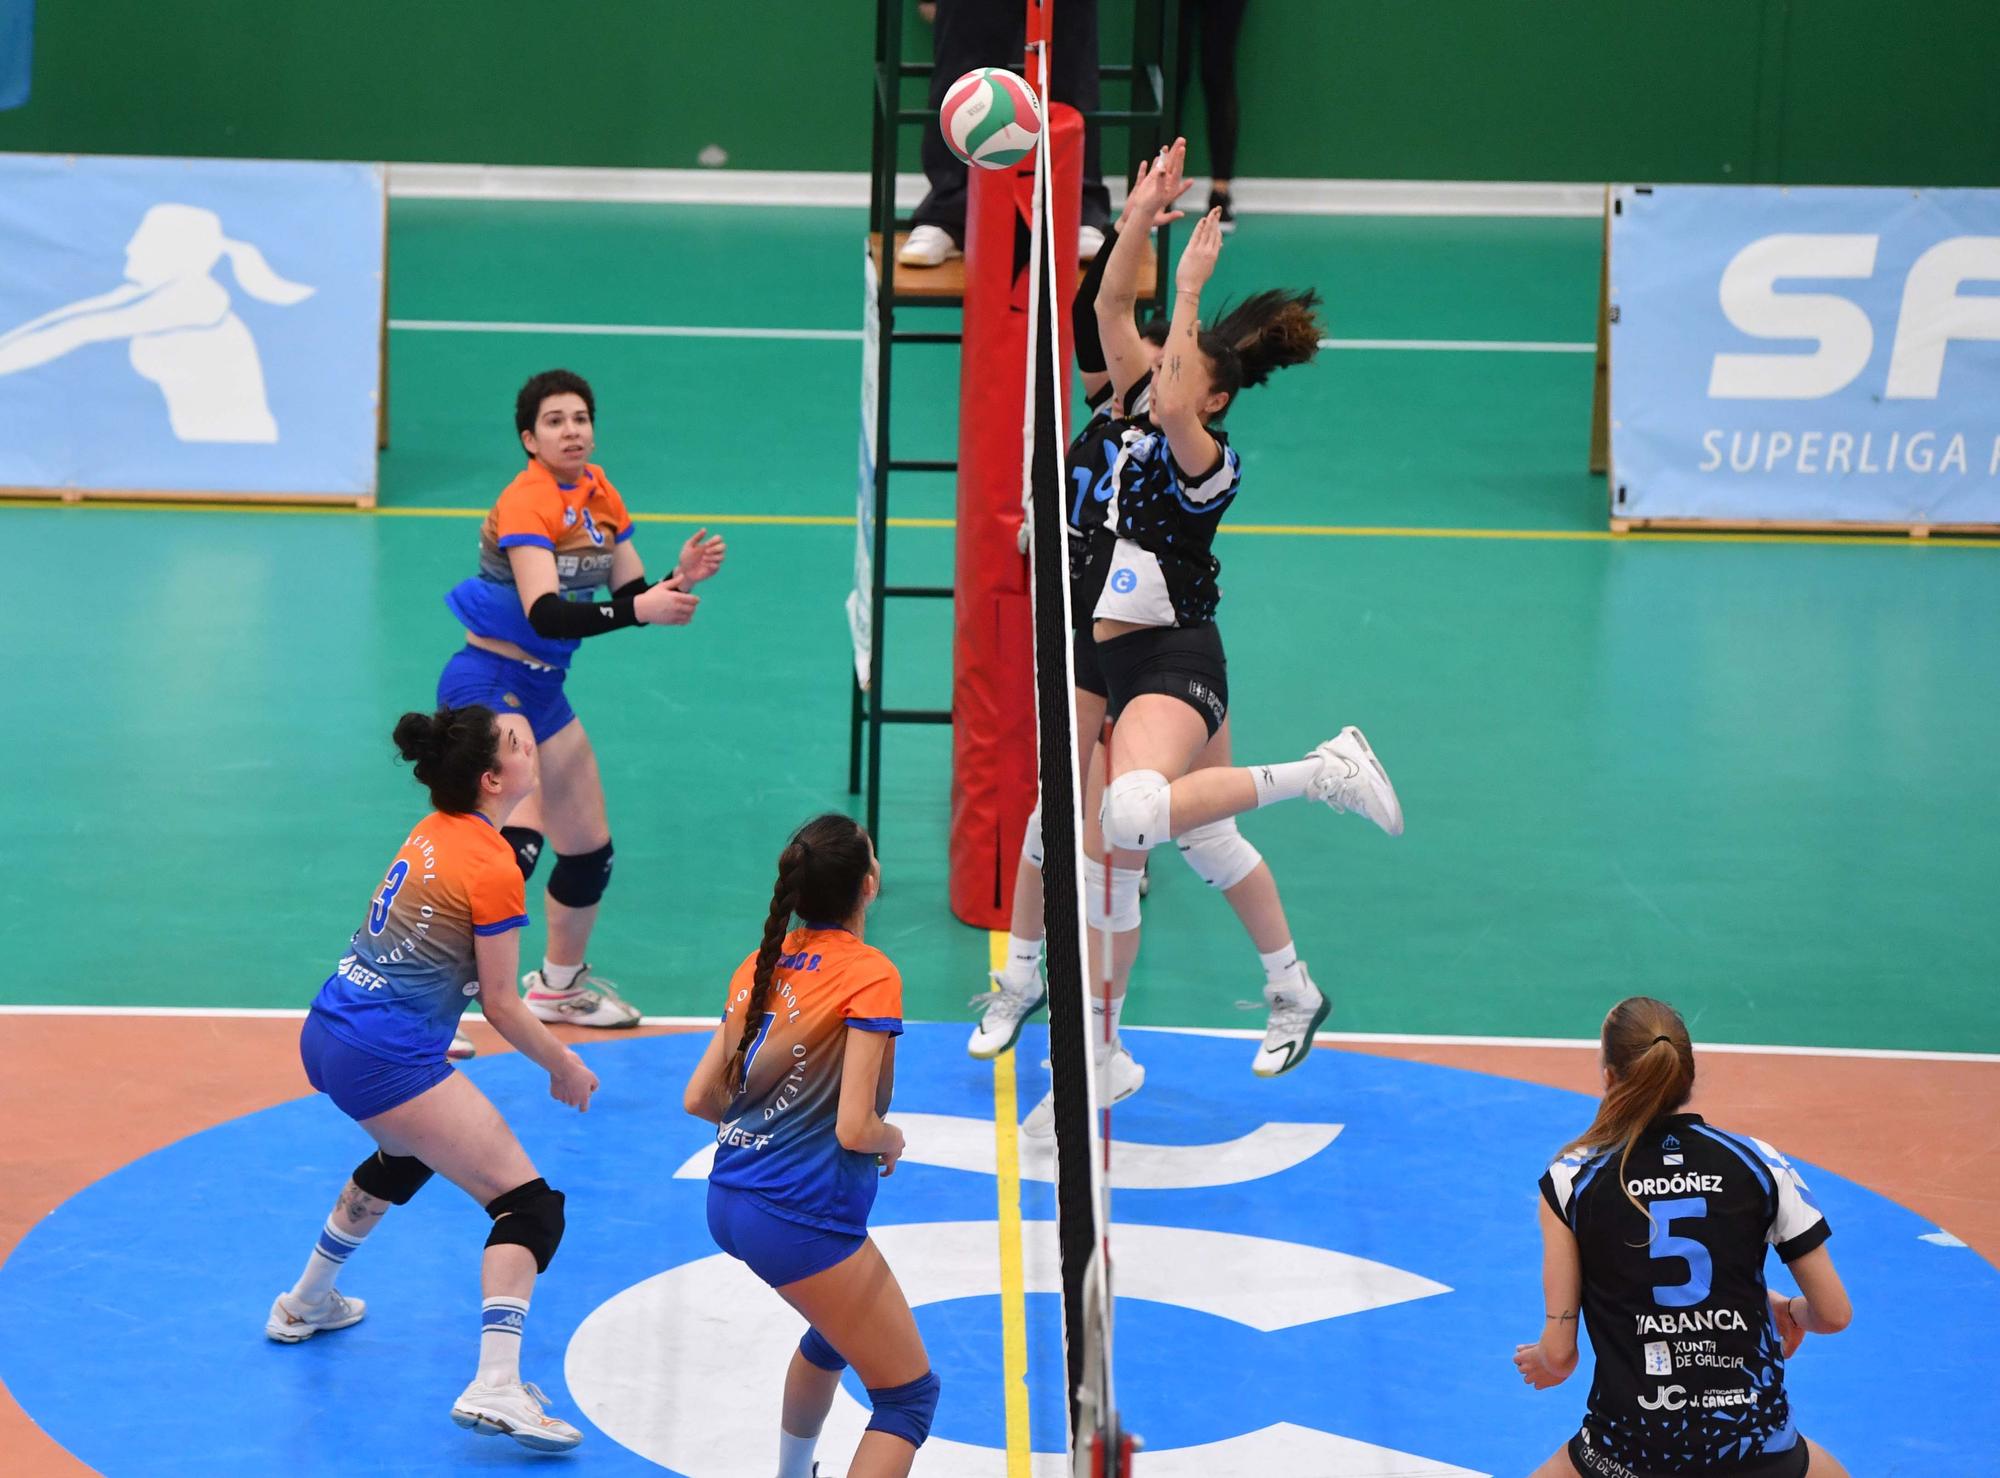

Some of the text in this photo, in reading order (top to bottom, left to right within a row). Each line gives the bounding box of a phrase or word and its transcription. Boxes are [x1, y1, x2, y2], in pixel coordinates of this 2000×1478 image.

[1699, 430, 1967, 475] SUPERLIGA
[368, 859, 410, 936] 3
[346, 964, 388, 991] GEFF
[764, 1044, 807, 1121] OVIEDO
[1627, 1172, 1723, 1196] ORDÓÑEZ
[1648, 1197, 1713, 1307] 5
[1642, 1309, 1748, 1334] ABANCA
[1673, 1341, 1717, 1354] XUNTA
[1675, 1354, 1744, 1369] DE GALICIA
[1637, 1385, 1687, 1411] JC
[1702, 1392, 1758, 1408] CANCELA
